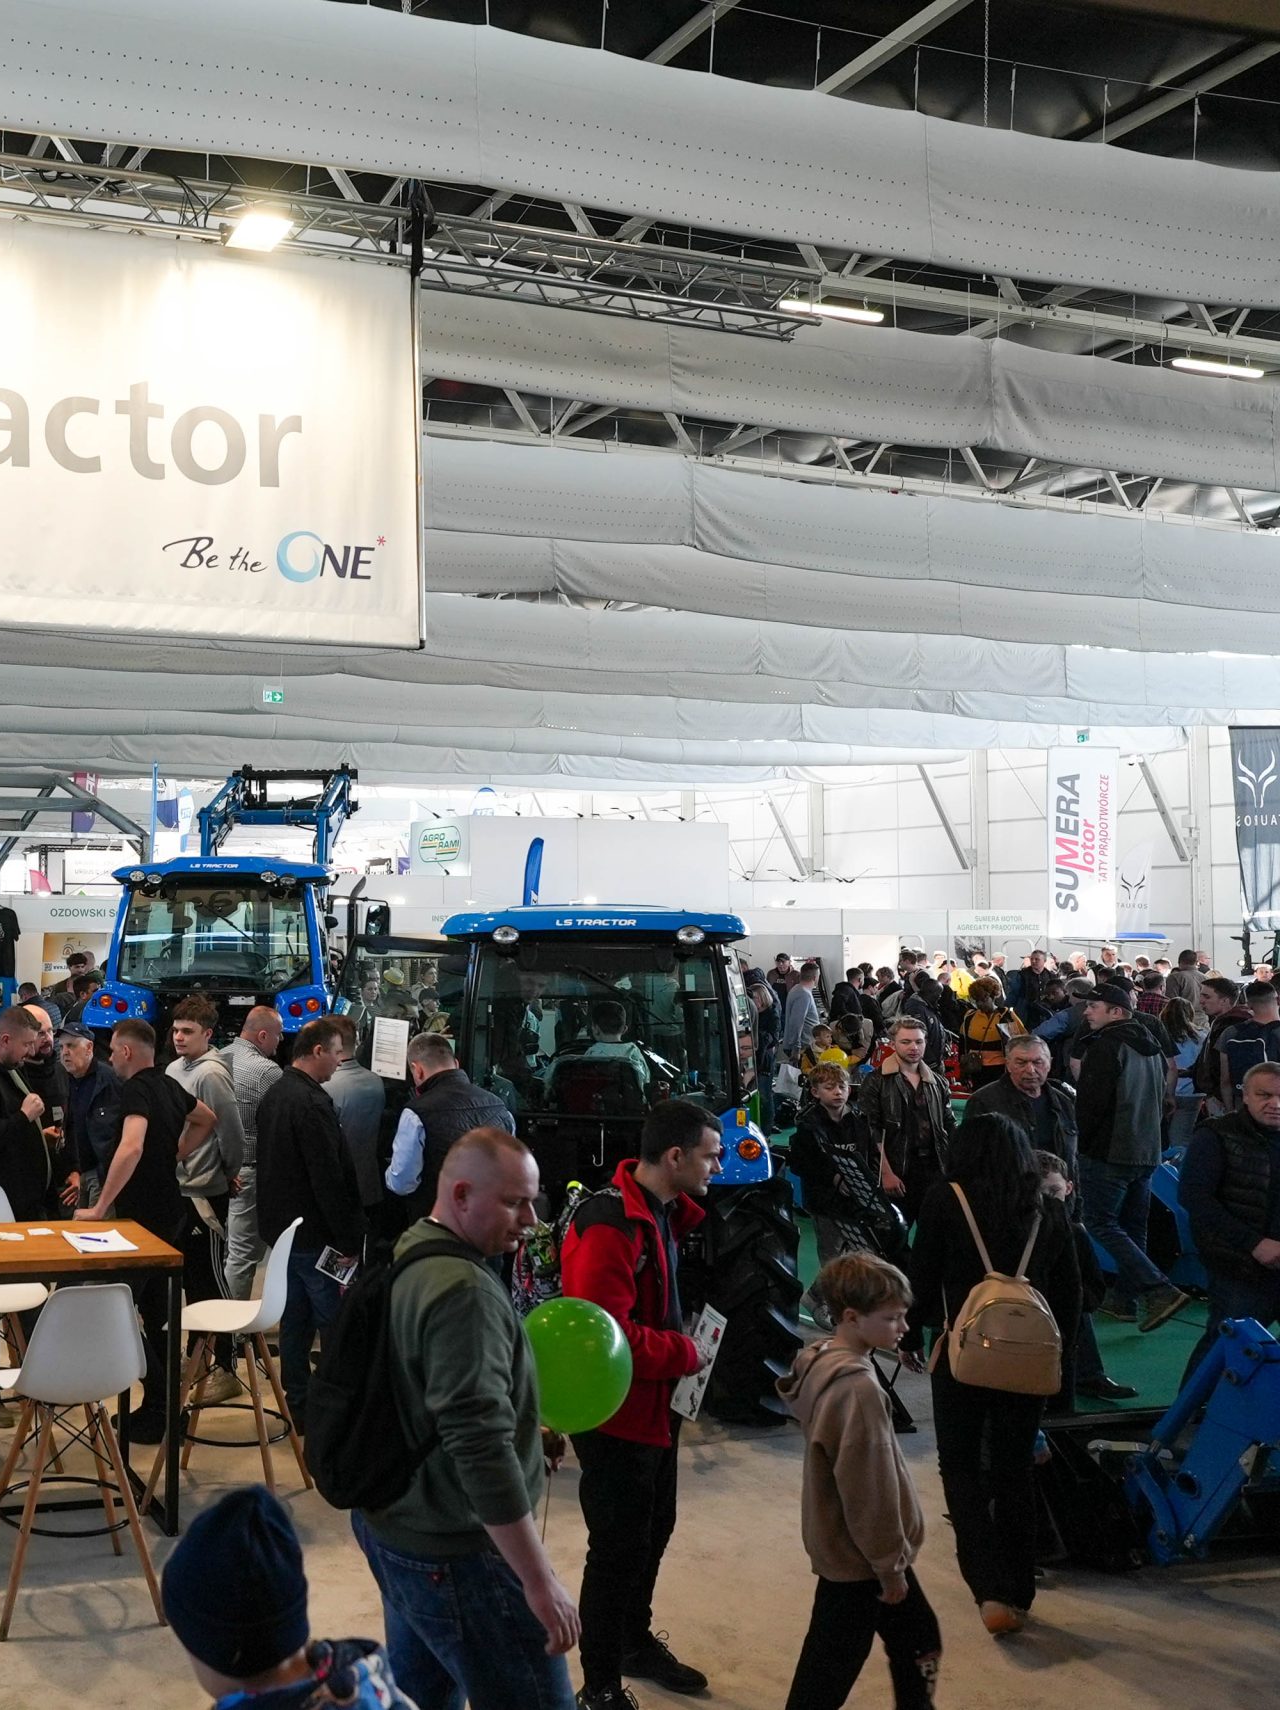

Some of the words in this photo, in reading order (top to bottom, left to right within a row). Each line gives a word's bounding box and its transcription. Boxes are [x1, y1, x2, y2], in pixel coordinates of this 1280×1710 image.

[162, 536, 219, 569] Be
[228, 546, 270, 573] the
[276, 530, 375, 583] ONE
[422, 832, 446, 843] AGRO
[1055, 774, 1080, 912] SUMERA
[437, 839, 460, 849] RAMI
[50, 907, 106, 918] OZDOWSKI
[555, 918, 573, 926] LS
[576, 918, 637, 927] TRACTOR
[957, 923, 989, 931] AGREGATY
